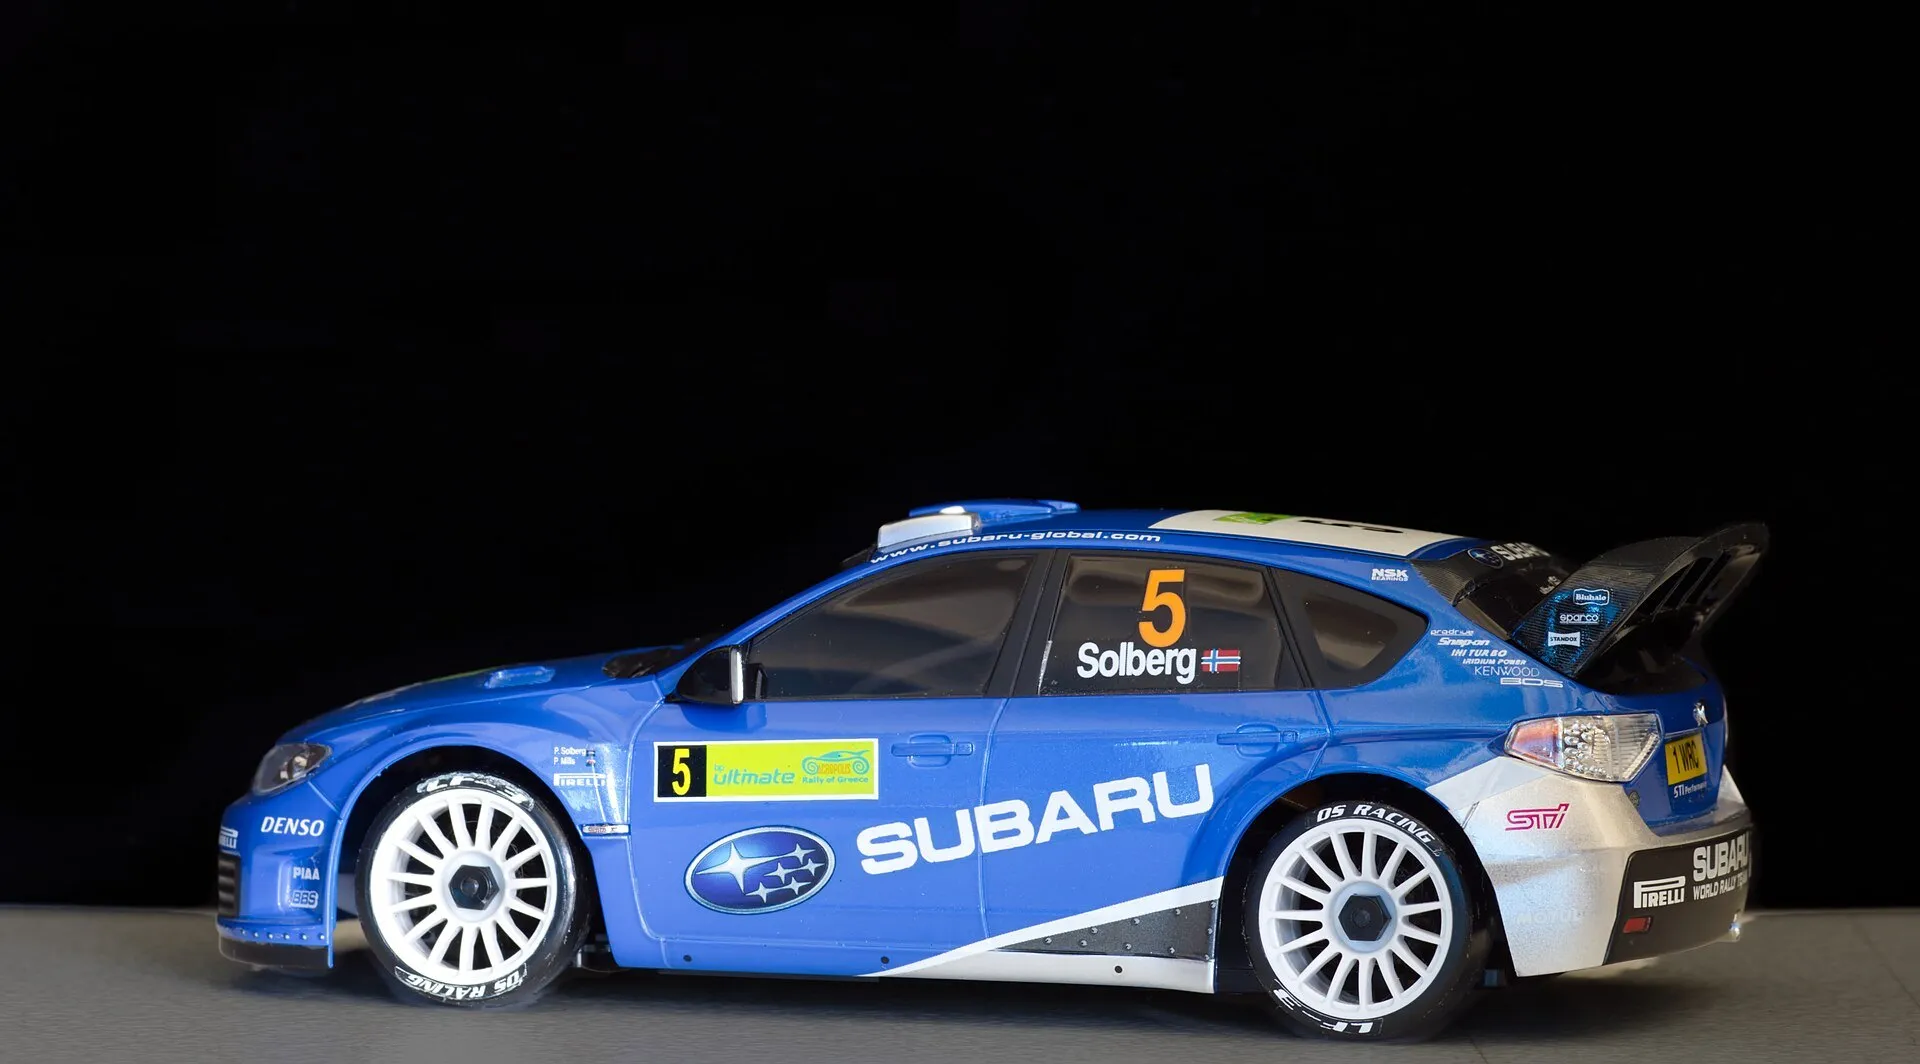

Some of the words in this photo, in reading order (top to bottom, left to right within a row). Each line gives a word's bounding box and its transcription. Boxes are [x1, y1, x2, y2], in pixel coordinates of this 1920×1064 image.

[870, 531, 1161, 564] www.subaru-global.com
[1372, 568, 1409, 578] NSK
[1138, 569, 1187, 648] 5
[1559, 613, 1600, 624] sparco
[1437, 637, 1490, 647] Snap-on
[1077, 641, 1197, 685] Solberg
[1451, 649, 1467, 657] IHI
[1474, 666, 1540, 677] KENWOOD
[560, 746, 587, 756] Solberg
[1673, 745, 1681, 774] 1
[1678, 740, 1700, 772] WRC
[671, 748, 691, 796] 5
[713, 768, 795, 786] ultimate
[714, 763, 725, 772] bp
[553, 772, 607, 787] PIRELLI
[802, 776, 824, 784] Rally
[260, 816, 325, 837] DENSO
[856, 763, 1215, 876] SUBARU
[1316, 804, 1347, 823] OS
[1353, 803, 1436, 844] RACING
[292, 866, 320, 880] PIAA
[291, 890, 318, 907] BBS
[1633, 876, 1686, 909] PIRELLI
[1693, 881, 1719, 901] WORLD
[1719, 876, 1737, 895] RALLY
[405, 974, 487, 1000] RACING
[493, 970, 520, 993] OS
[1273, 988, 1374, 1034] LF-3
